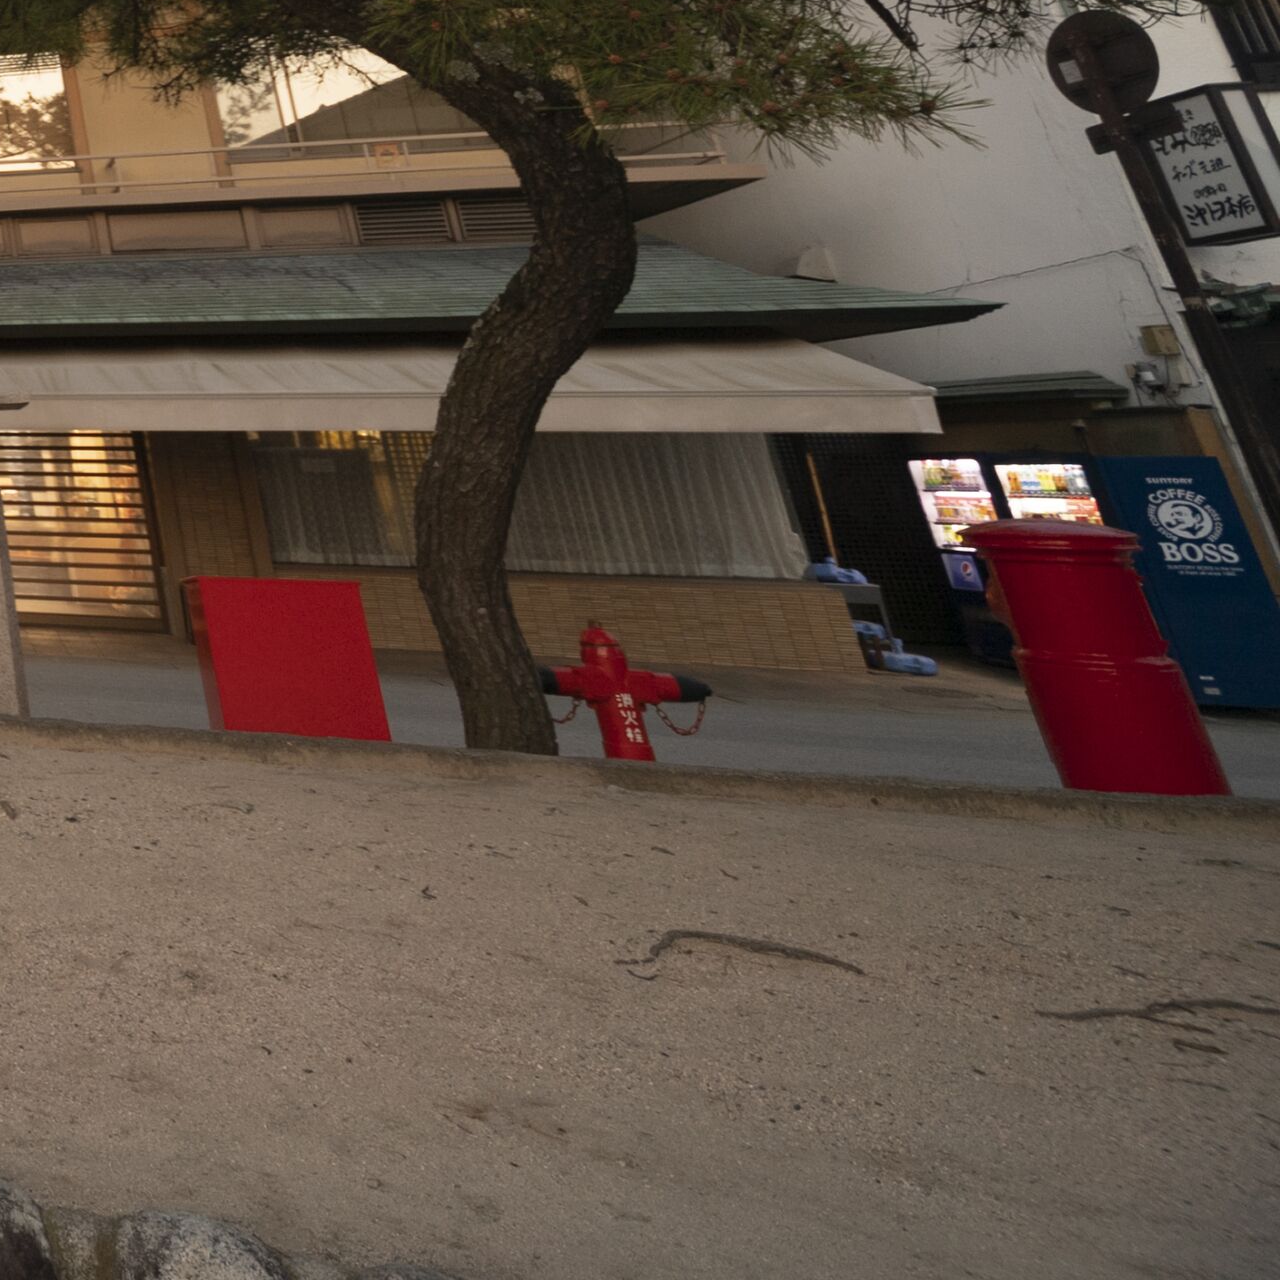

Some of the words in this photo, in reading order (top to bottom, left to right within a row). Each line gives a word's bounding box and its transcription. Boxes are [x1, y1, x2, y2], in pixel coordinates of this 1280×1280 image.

[1148, 488, 1207, 506] COFFEE
[1158, 542, 1241, 563] BOSS
[615, 693, 645, 743] 消火栓
